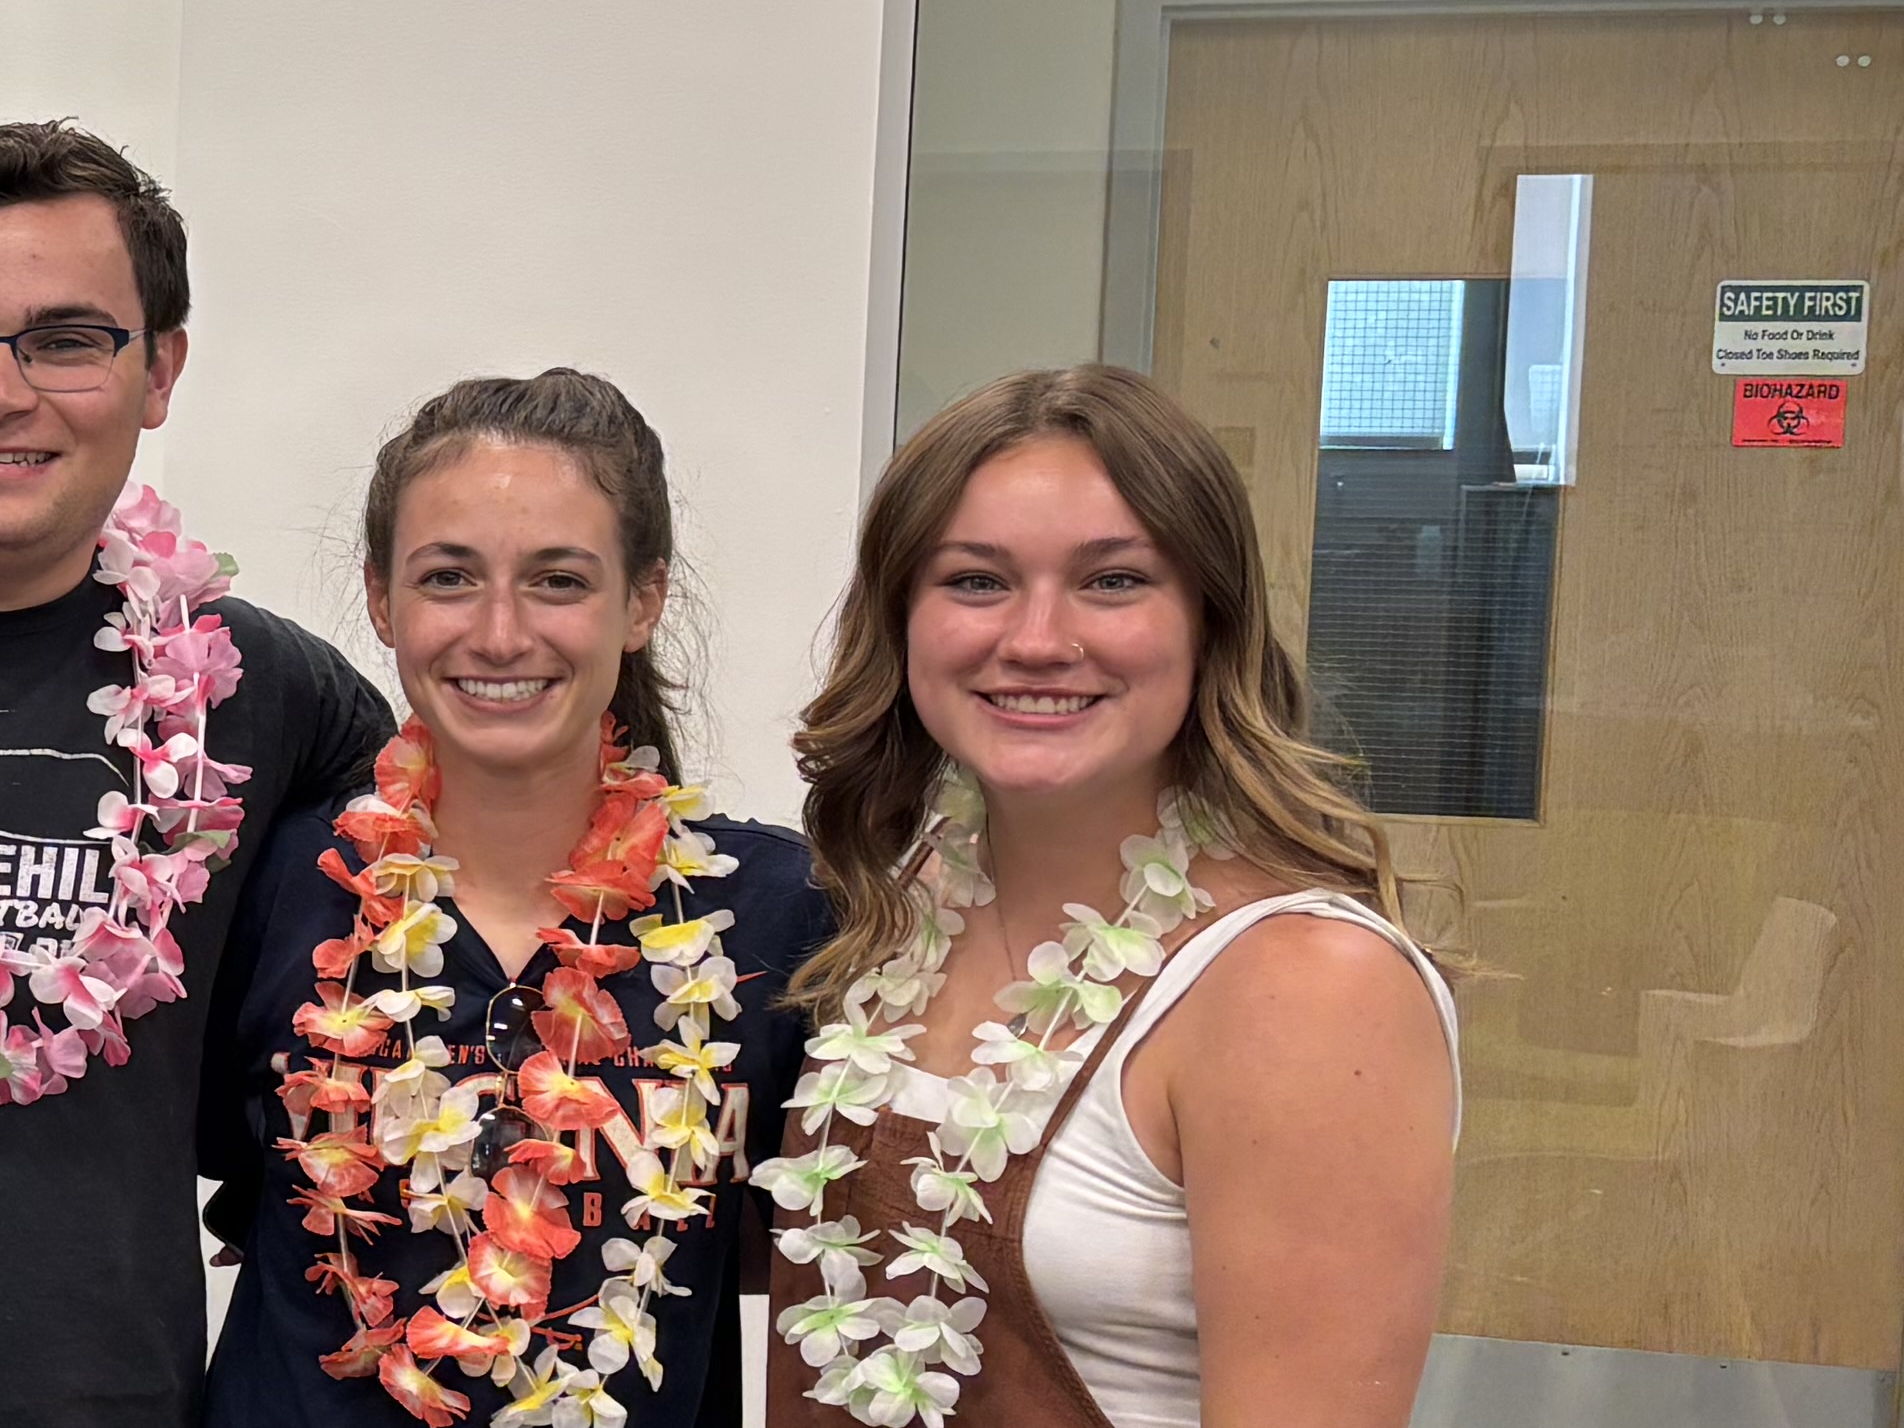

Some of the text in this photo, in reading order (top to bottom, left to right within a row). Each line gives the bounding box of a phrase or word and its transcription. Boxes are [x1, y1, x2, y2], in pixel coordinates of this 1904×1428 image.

[1722, 291, 1861, 317] SAFETY FIRST
[1743, 329, 1835, 341] No Food Or Drink
[1716, 348, 1860, 363] Closed Toe Shoes Required
[1742, 383, 1840, 400] BIOHAZARD
